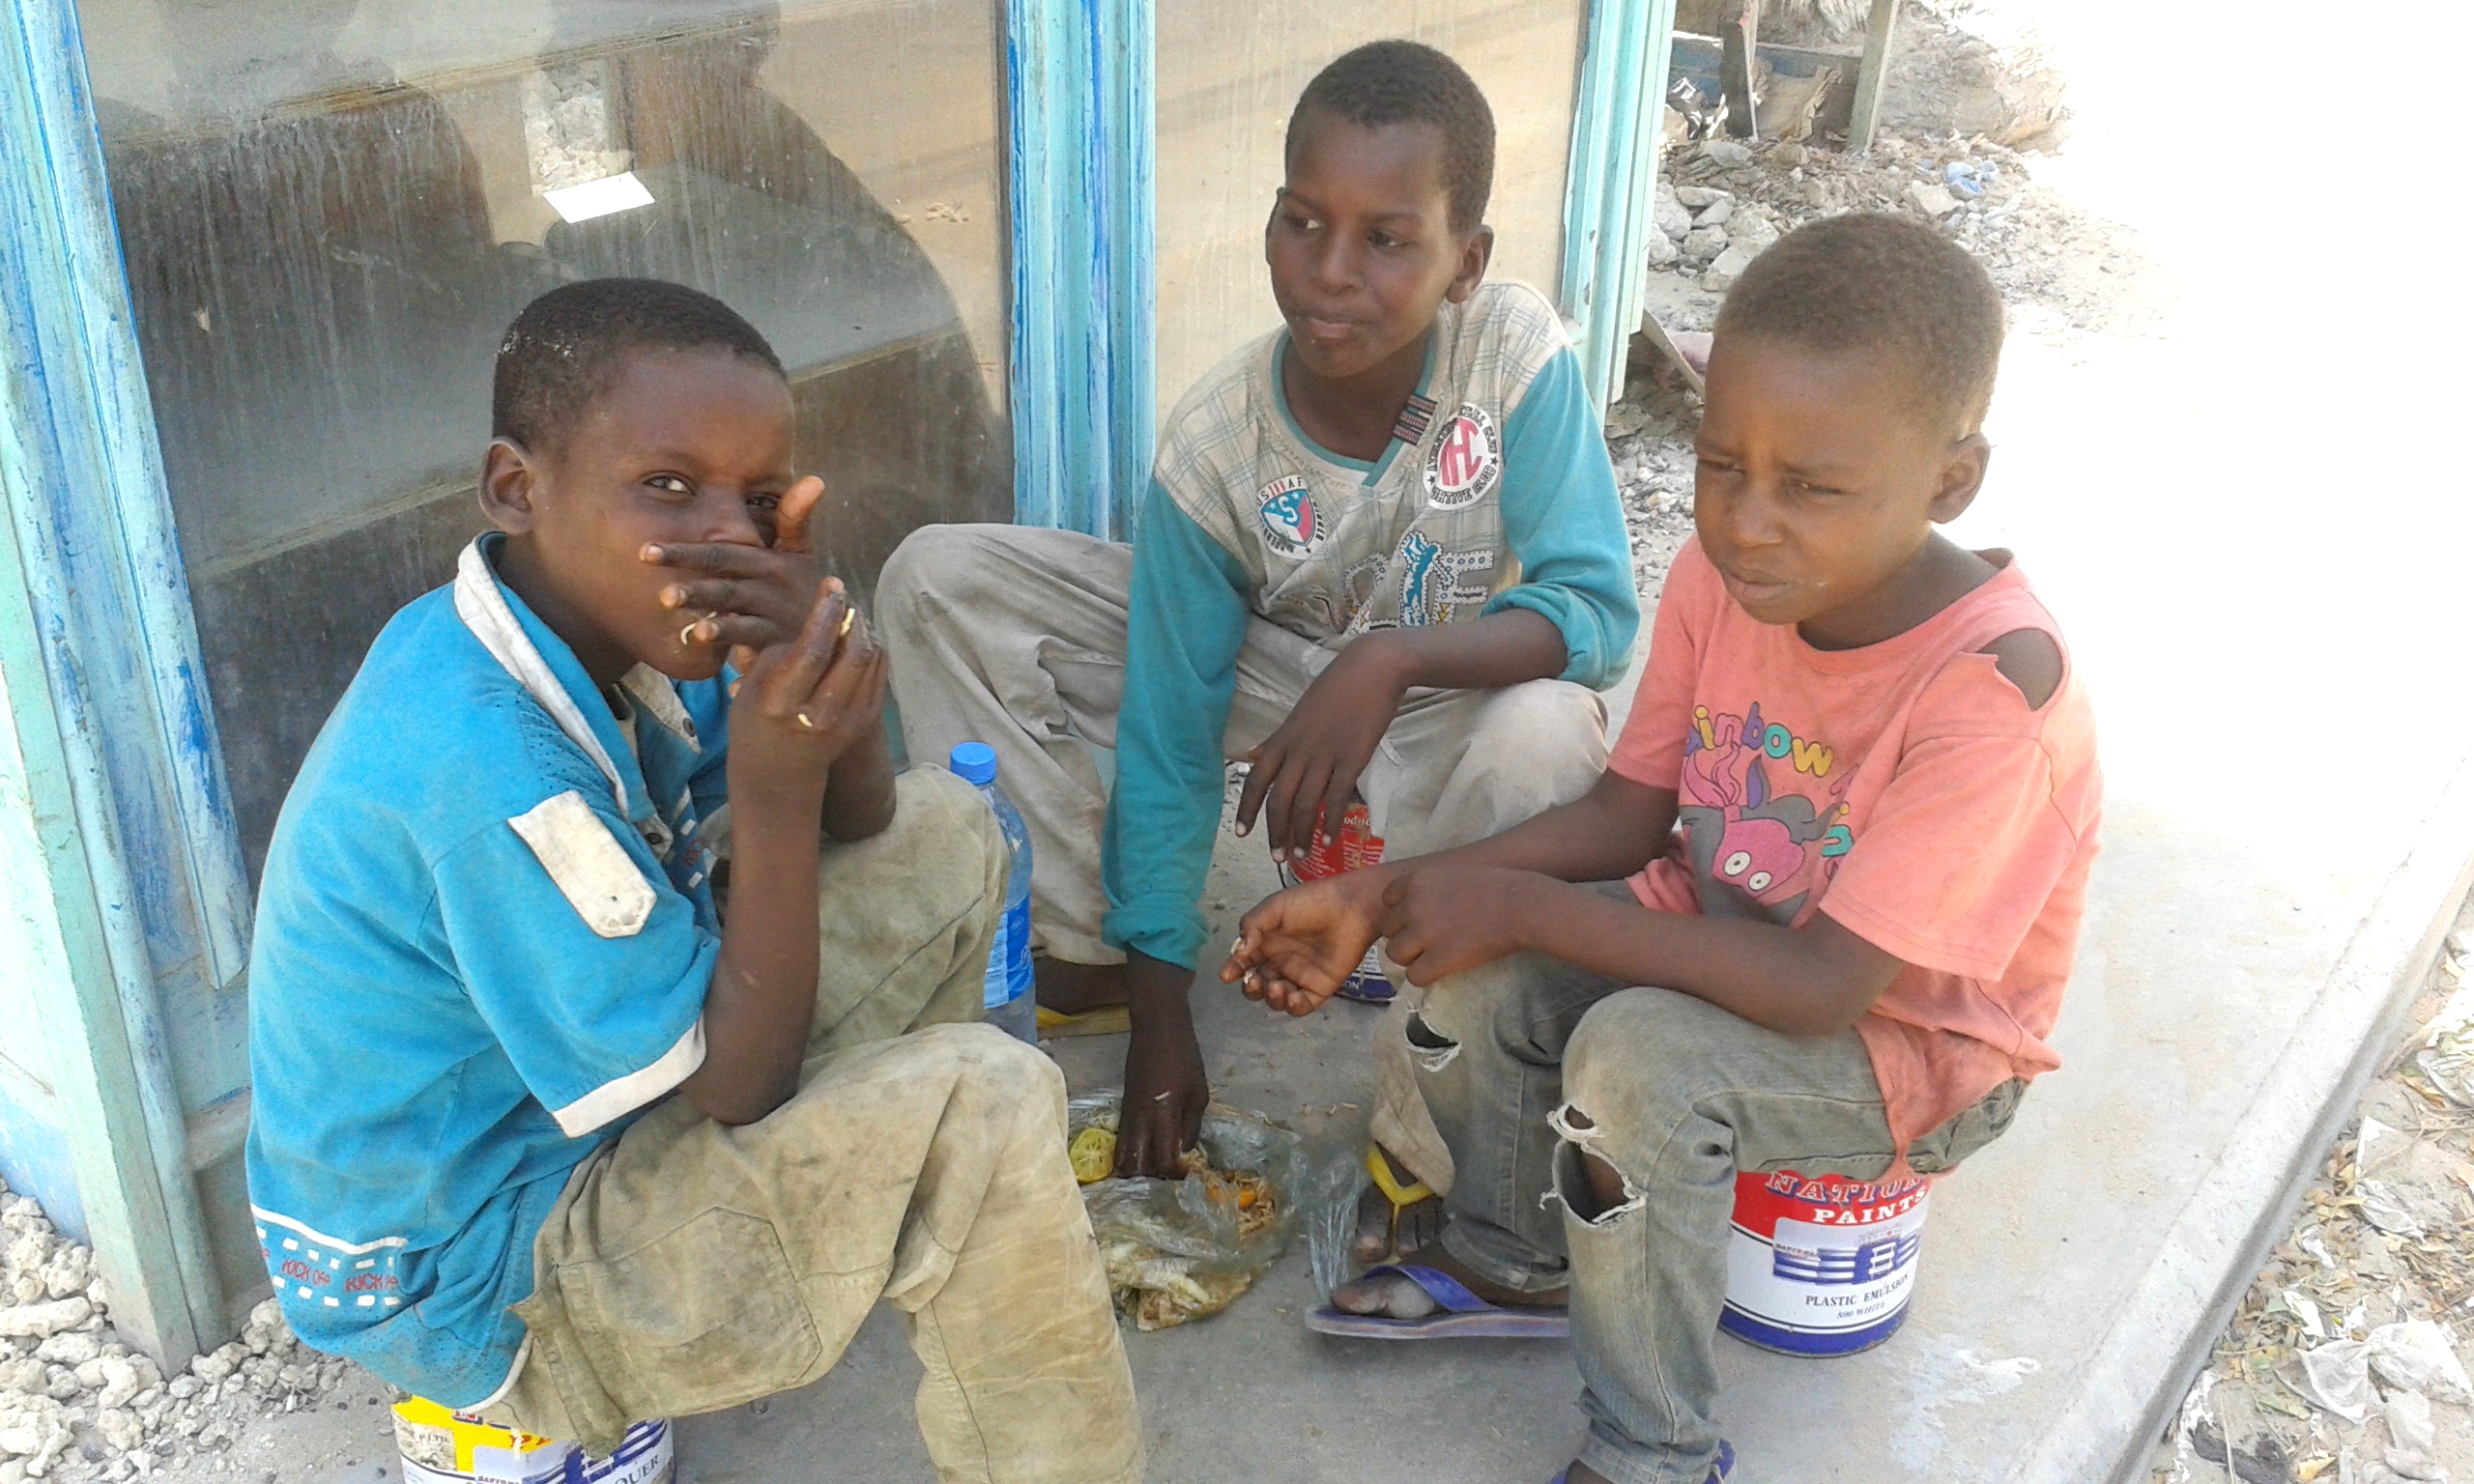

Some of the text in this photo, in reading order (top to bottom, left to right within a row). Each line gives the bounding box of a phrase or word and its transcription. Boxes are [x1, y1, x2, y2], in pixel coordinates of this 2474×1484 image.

[1813, 1184, 1926, 1224] PAINTS
[1805, 1295, 1857, 1307] PLASTIC
[1863, 1273, 1909, 1302] EMULSION
